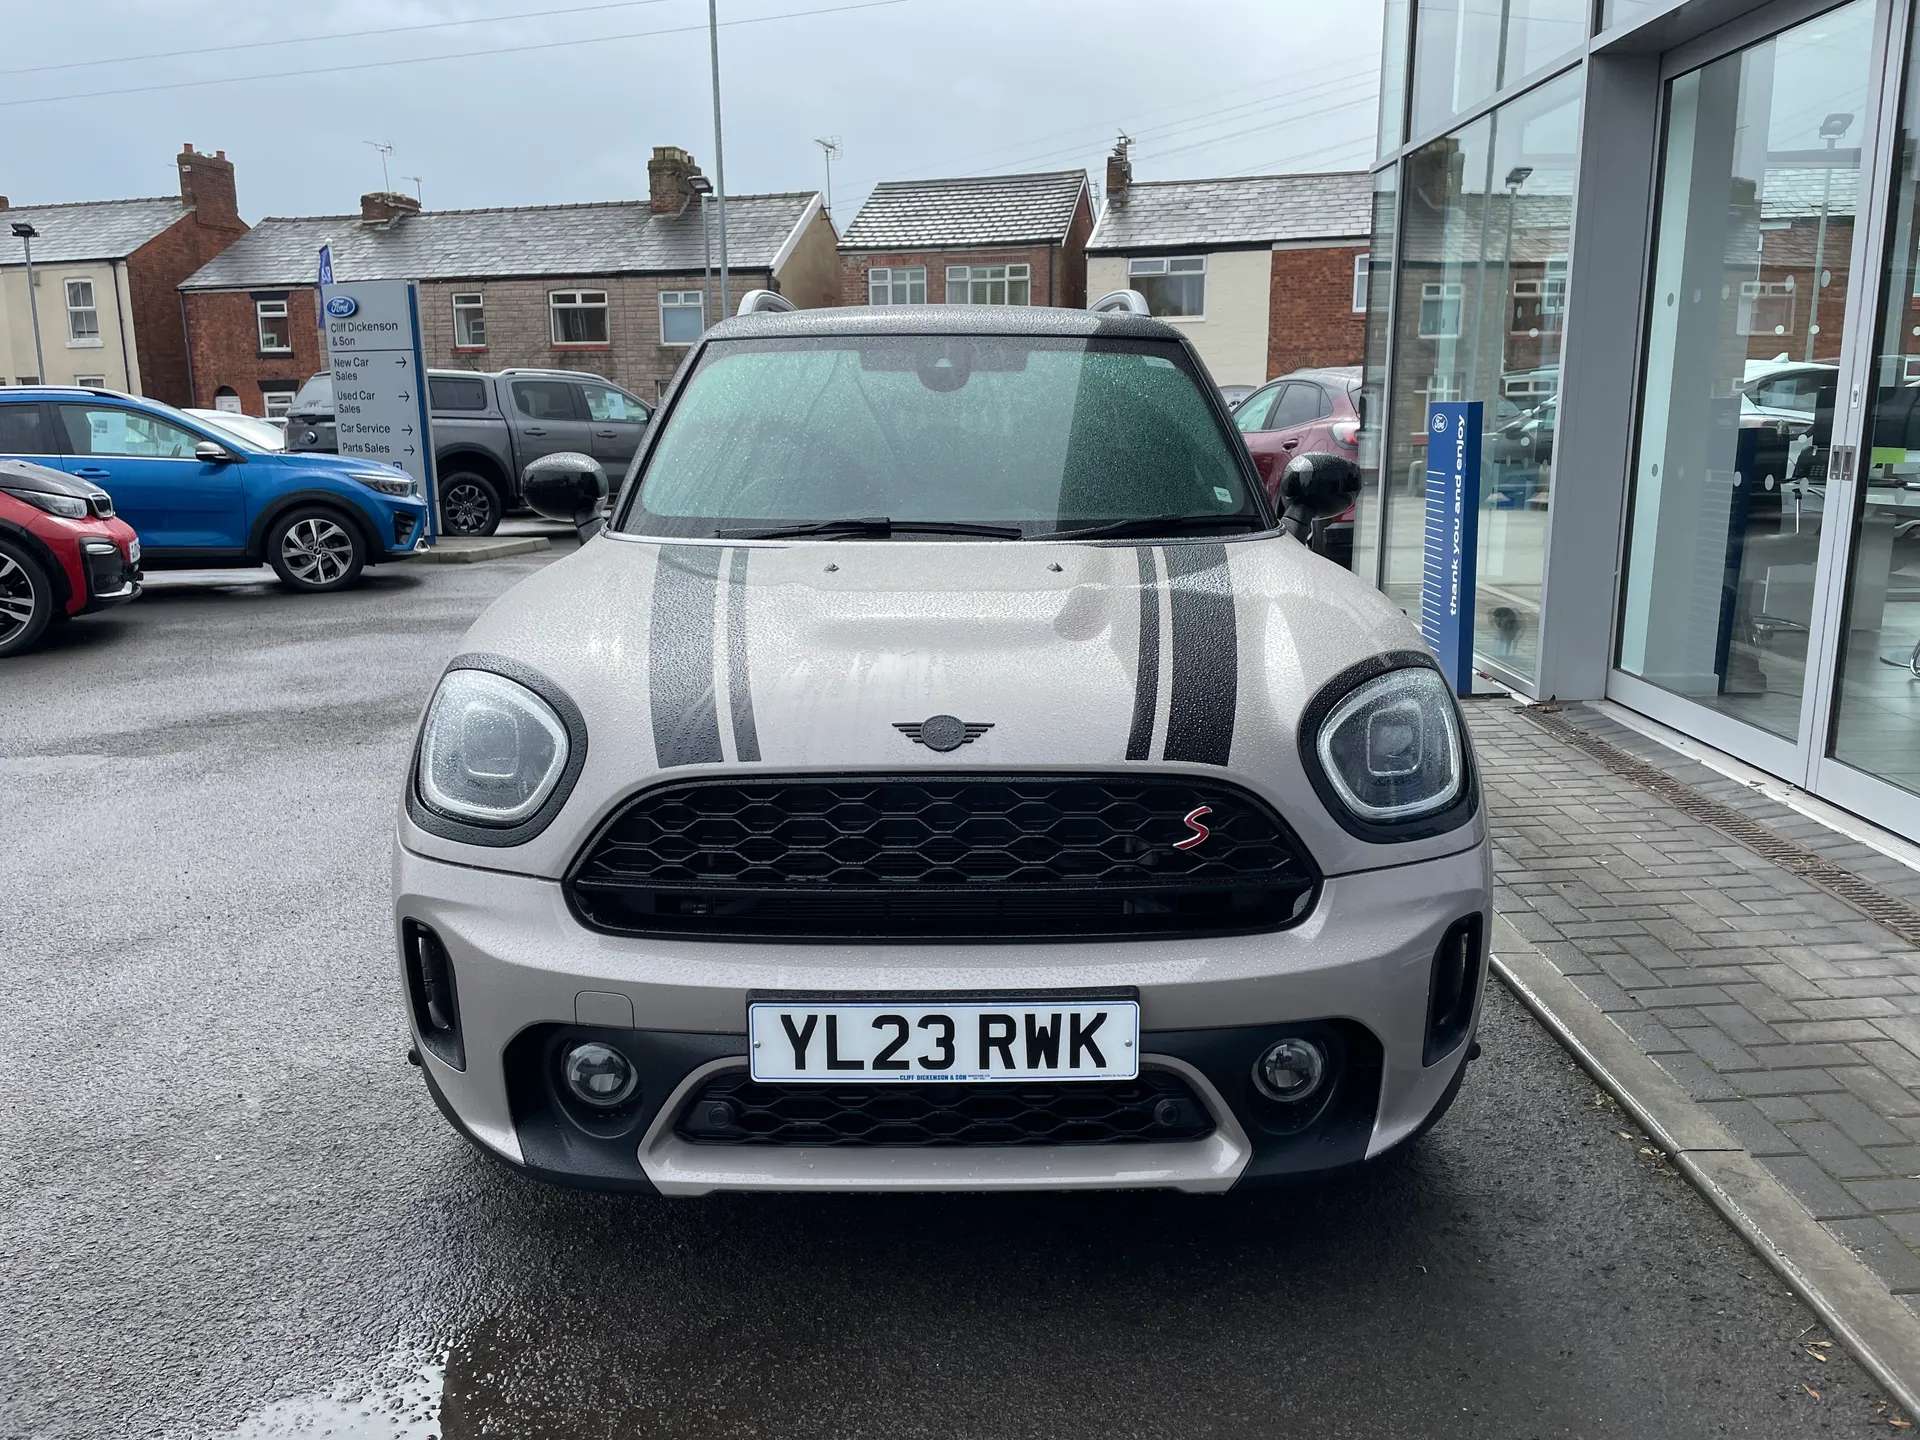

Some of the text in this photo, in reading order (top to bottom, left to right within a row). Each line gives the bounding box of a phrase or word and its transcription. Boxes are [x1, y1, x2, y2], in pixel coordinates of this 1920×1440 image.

[331, 321, 398, 333] Cliff Dickenson
[332, 336, 356, 346] & Son
[334, 357, 369, 368] New Car
[335, 371, 358, 381] Sales
[337, 390, 376, 401] Used Car
[338, 404, 361, 414] Sales
[340, 423, 391, 434] Car Service
[342, 442, 390, 454] Parts Sales
[1456, 414, 1465, 471] enjoy
[1454, 475, 1462, 514] and
[1449, 558, 1458, 617] thank
[1172, 805, 1213, 850] S
[780, 1012, 1108, 1071] YL23 RWK
